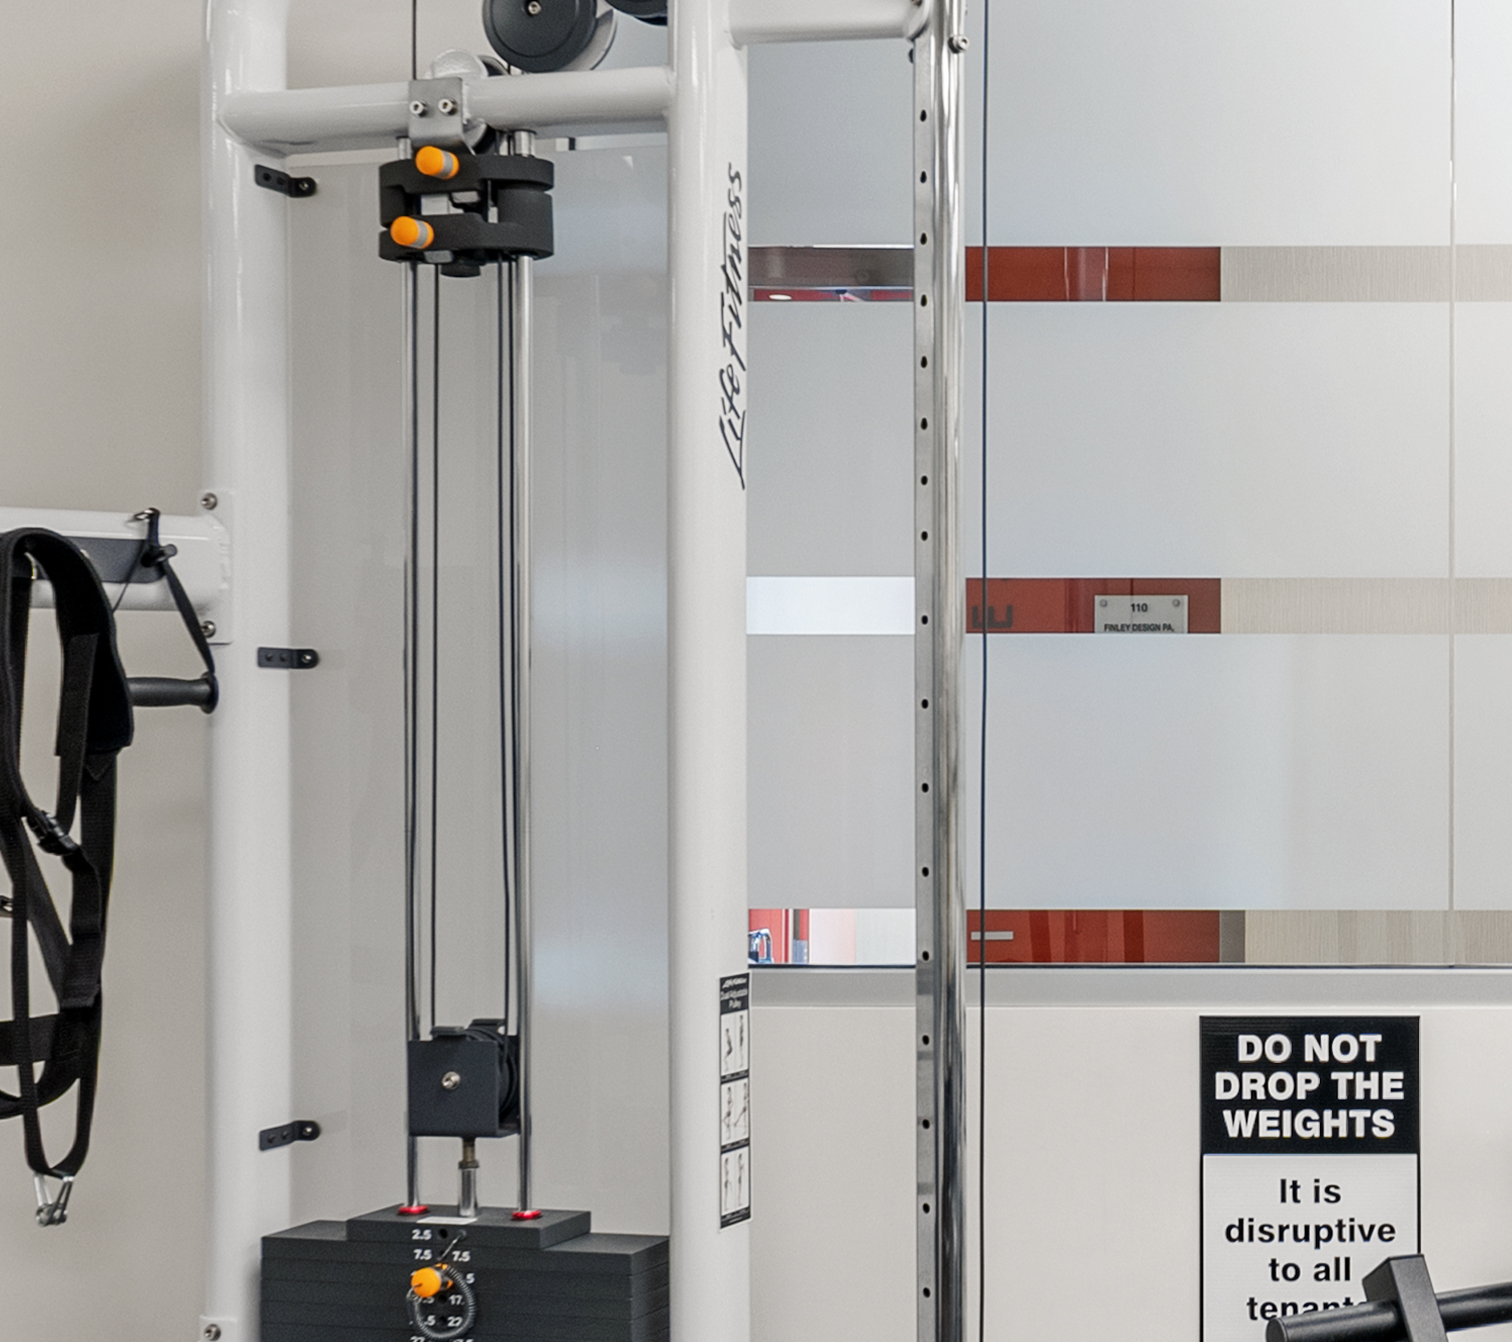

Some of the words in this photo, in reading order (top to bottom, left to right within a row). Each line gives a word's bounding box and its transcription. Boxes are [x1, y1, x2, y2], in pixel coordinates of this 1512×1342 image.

[720, 162, 746, 372] Fitness
[719, 363, 746, 490] Life
[1130, 603, 1148, 613] 110
[1104, 623, 1131, 632] FINLEY
[1132, 623, 1161, 632] DESIGN
[1238, 1034, 1292, 1063] DO
[1304, 1034, 1382, 1063] NOT
[1215, 1071, 1320, 1100] DROP
[1330, 1071, 1405, 1100] THE
[1223, 1109, 1395, 1138] WEIGHTS
[1280, 1179, 1301, 1204] It
[1313, 1179, 1341, 1204] is
[412, 1229, 432, 1240] 2.5
[1225, 1217, 1396, 1249] disruptive
[414, 1249, 432, 1260] 7.5
[452, 1251, 471, 1262] 7.5
[1268, 1257, 1301, 1282] to
[1313, 1257, 1351, 1282] all
